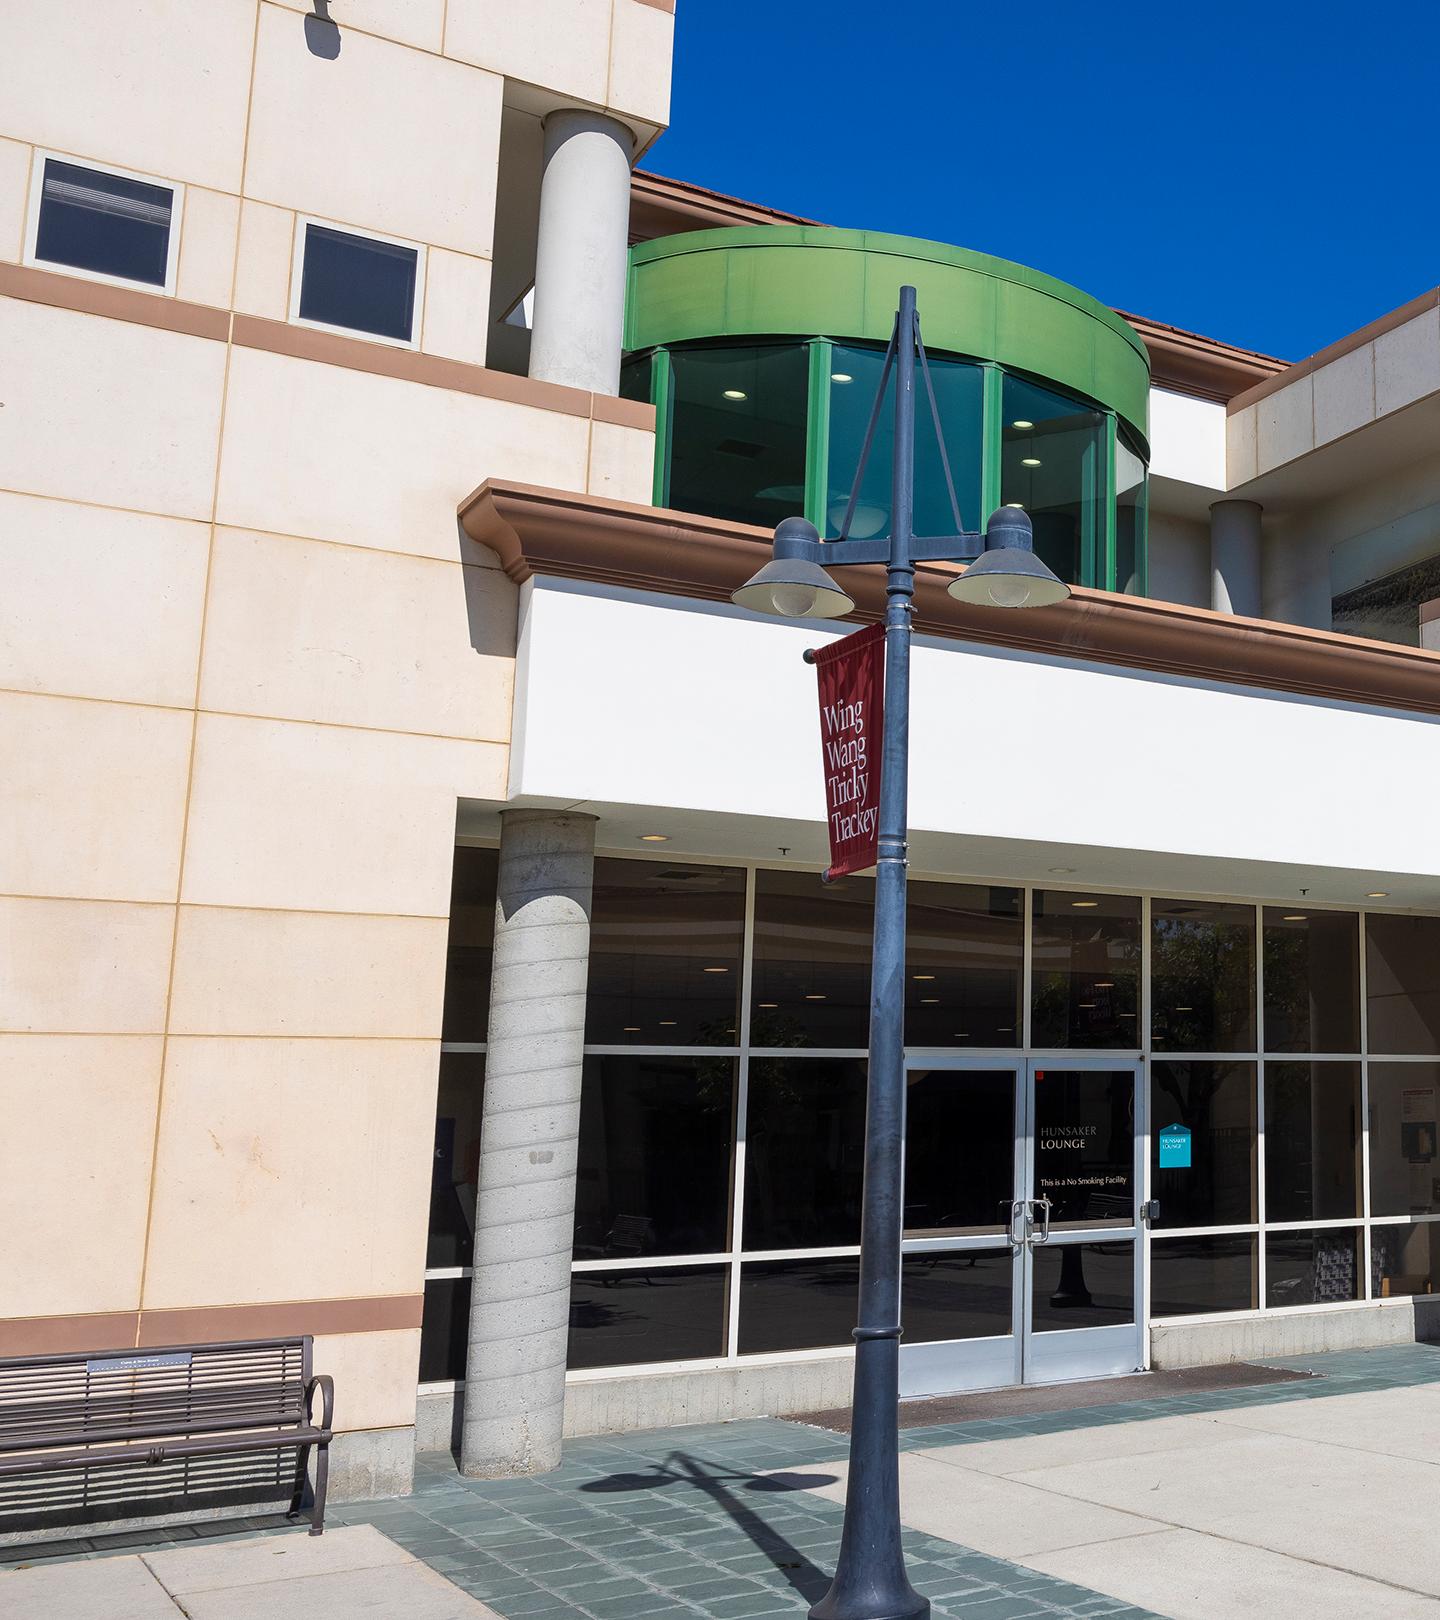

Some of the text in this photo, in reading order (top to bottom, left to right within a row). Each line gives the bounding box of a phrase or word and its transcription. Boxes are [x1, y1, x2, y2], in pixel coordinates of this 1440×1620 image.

[824, 699, 863, 736] Wing
[826, 736, 867, 772] Wang
[829, 766, 869, 808] Tricky
[832, 802, 878, 844] Trackey
[1041, 1126, 1096, 1136] HUNSAKER
[1041, 1138, 1086, 1150] LOUNGE
[1040, 1178, 1054, 1186] This
[1078, 1176, 1104, 1186] Smoking
[1106, 1176, 1127, 1185] Facility
